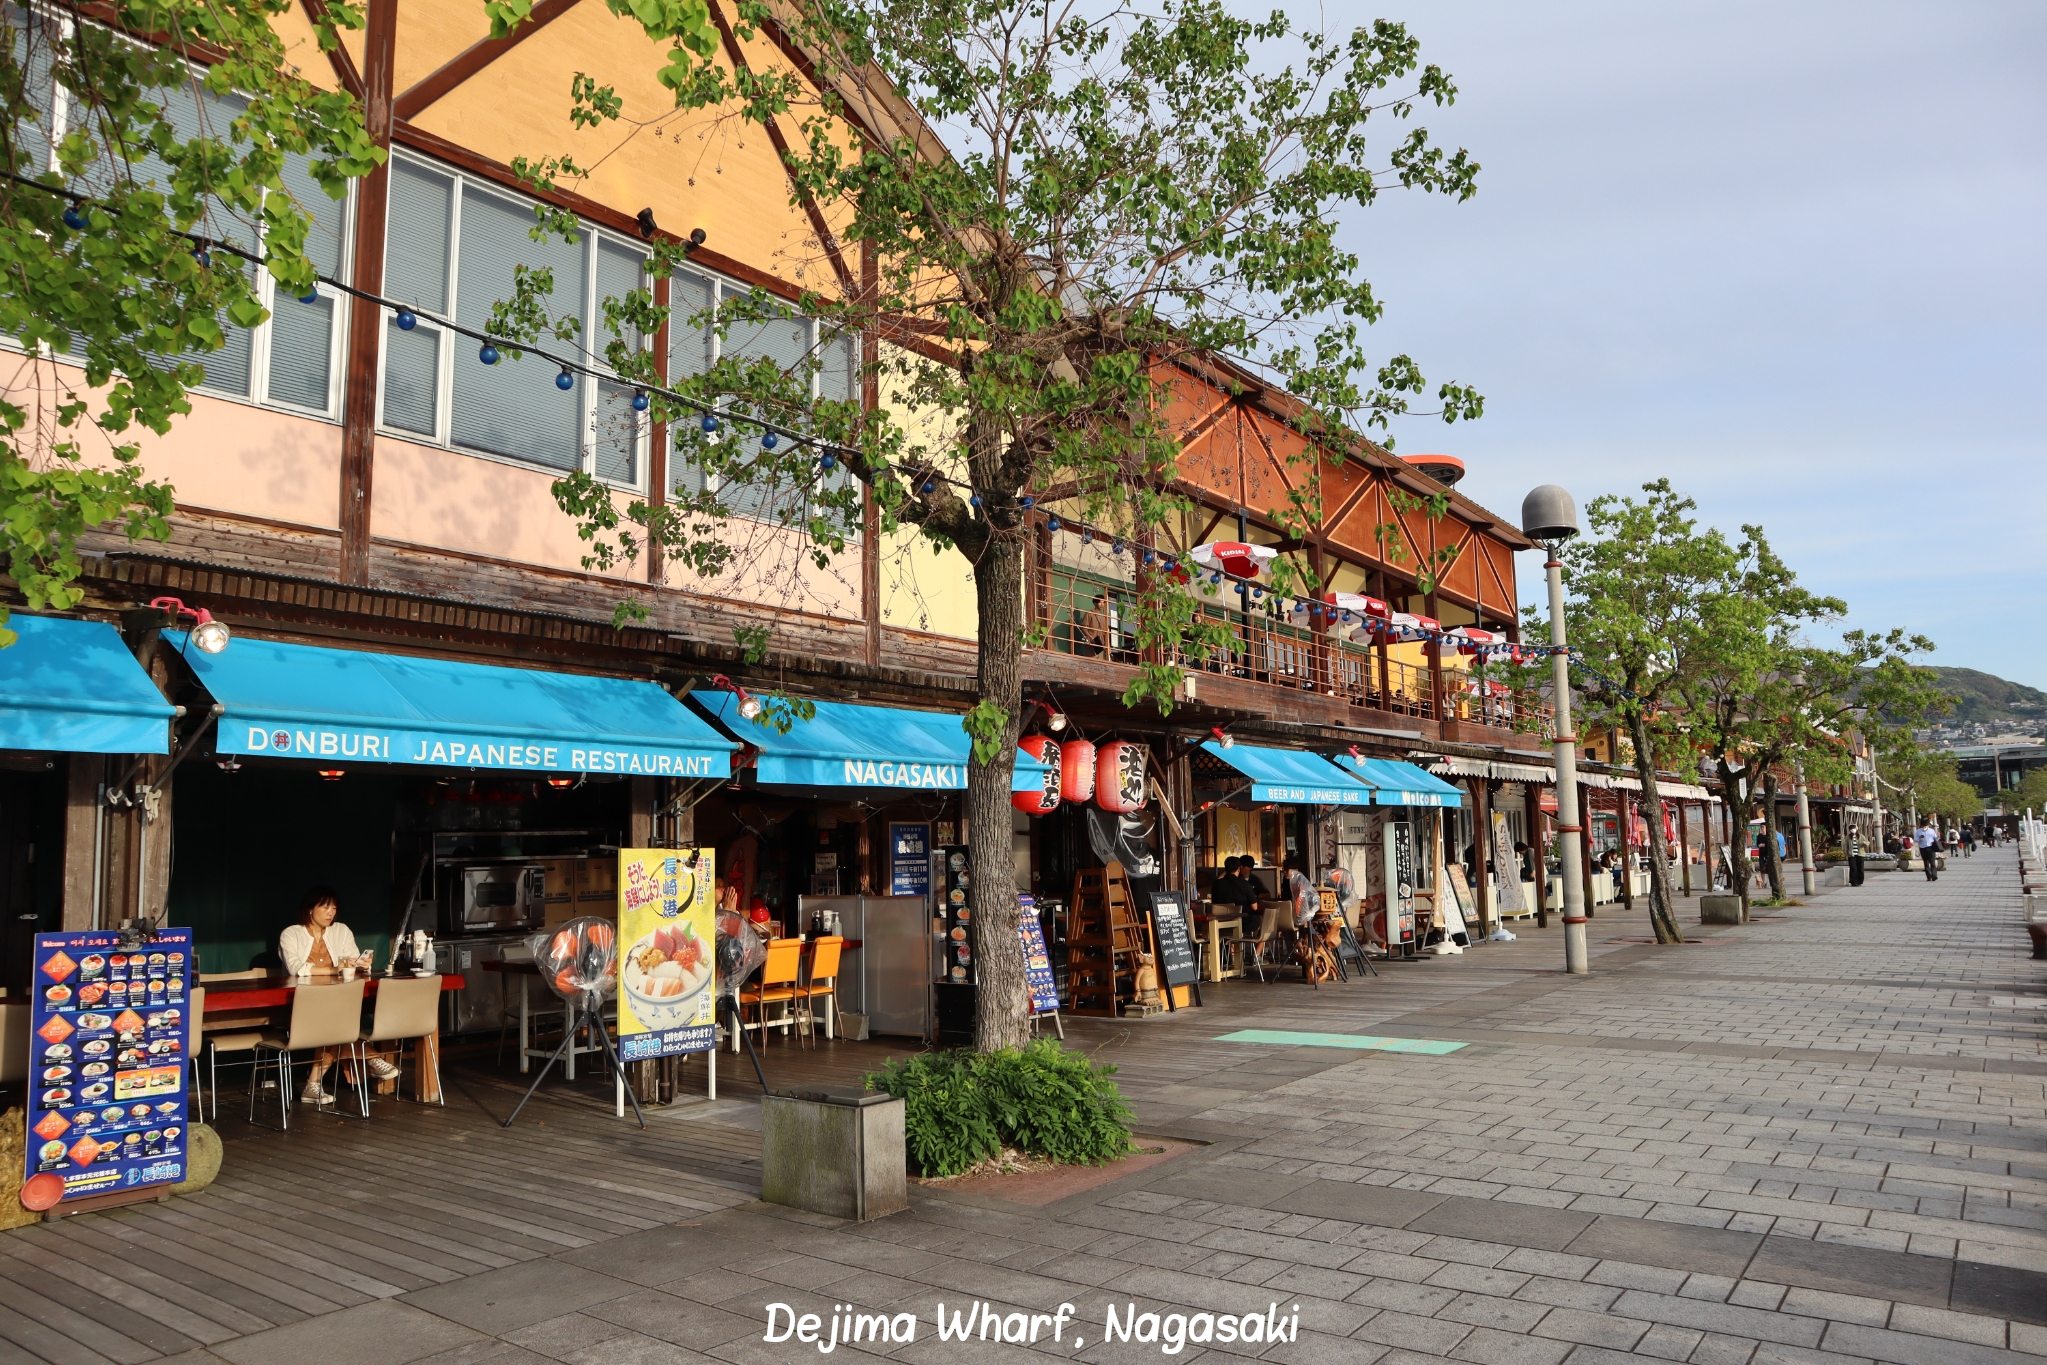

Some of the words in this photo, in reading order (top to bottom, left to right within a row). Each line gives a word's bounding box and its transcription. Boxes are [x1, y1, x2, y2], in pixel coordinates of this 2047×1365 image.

[1220, 549, 1246, 557] KIRIN
[248, 727, 391, 759] DONBURI
[414, 740, 558, 768] JAPANESE
[571, 750, 712, 776] RESTAURANT
[844, 758, 957, 788] NAGASAKI
[1267, 788, 1288, 800] BEER
[1290, 789, 1306, 801] AND
[1309, 789, 1341, 802] JAPANESE
[1342, 791, 1360, 803] SAKE
[1401, 790, 1442, 807] Welcome
[662, 857, 678, 919] 長崎港
[700, 994, 711, 1021] 海鮮丼
[624, 1038, 662, 1060] 長崎港
[142, 1163, 181, 1182] 長崎港
